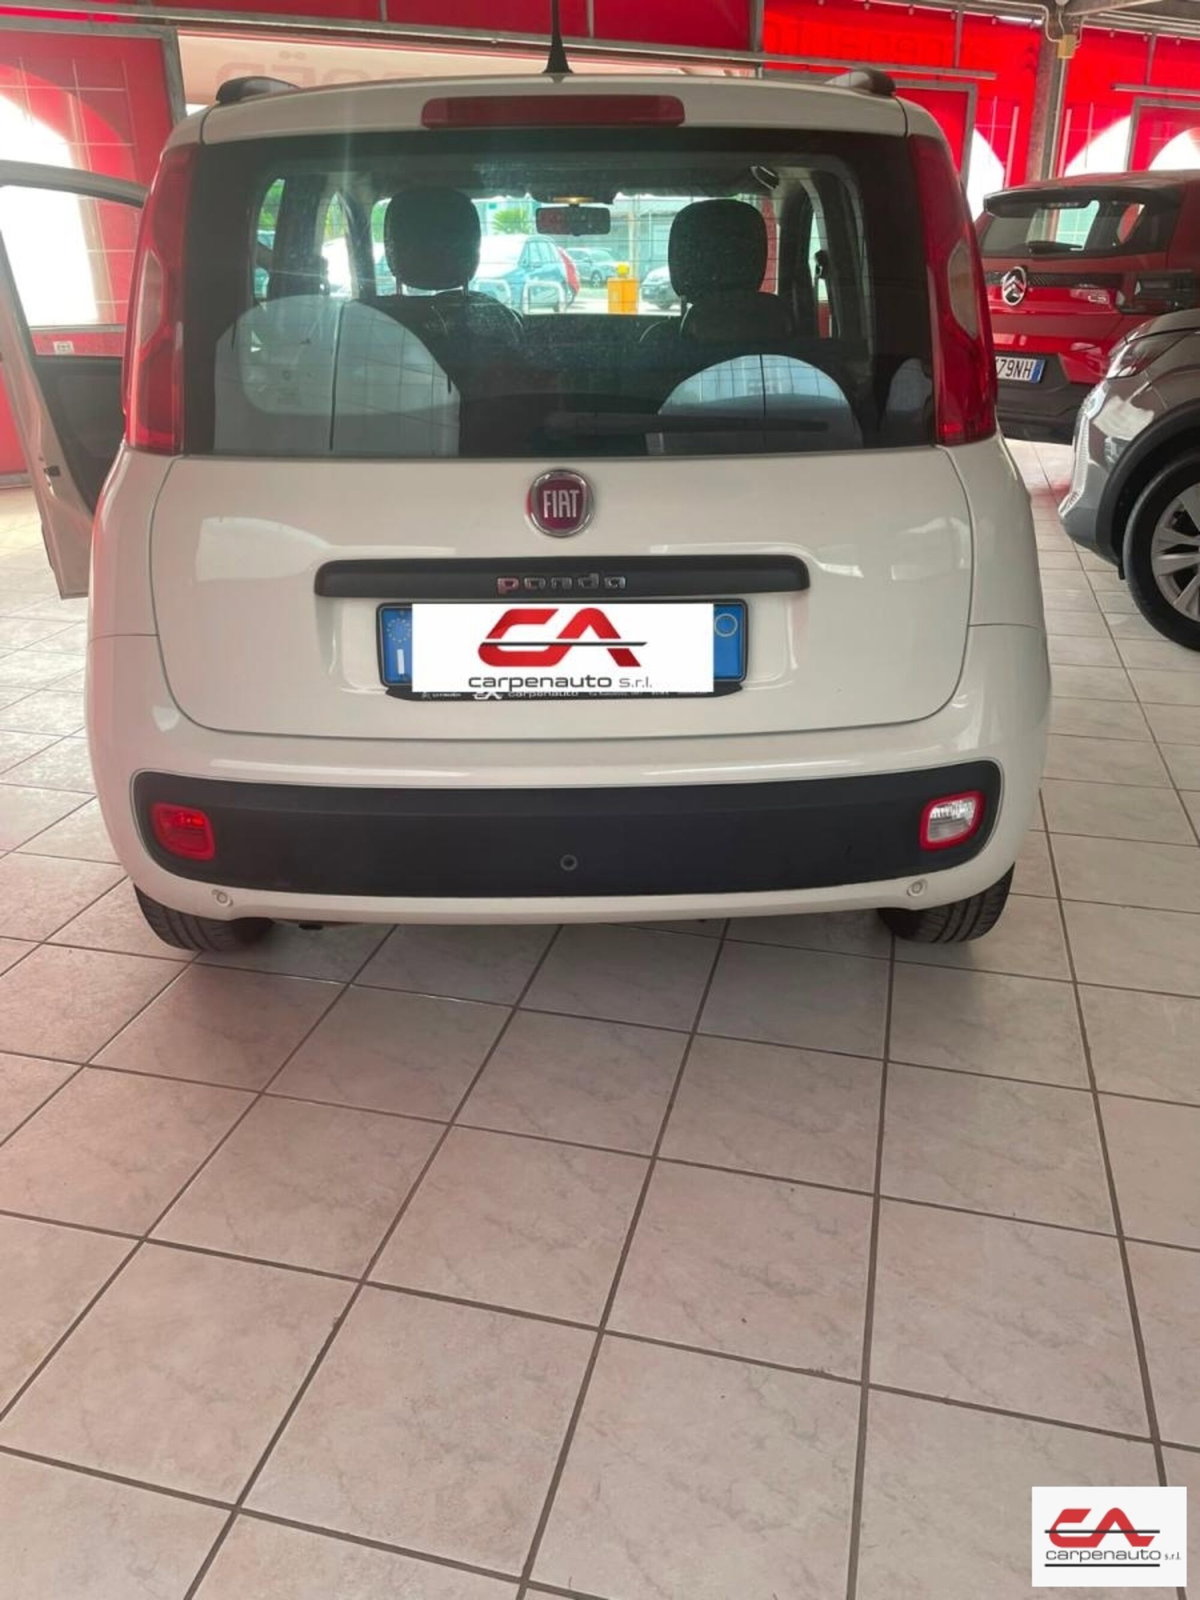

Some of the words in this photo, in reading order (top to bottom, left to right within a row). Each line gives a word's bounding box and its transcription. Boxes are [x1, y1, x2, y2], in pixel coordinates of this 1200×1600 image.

[996, 358, 1034, 379] 79NH
[543, 489, 580, 519] FIAT
[497, 573, 626, 594] panda
